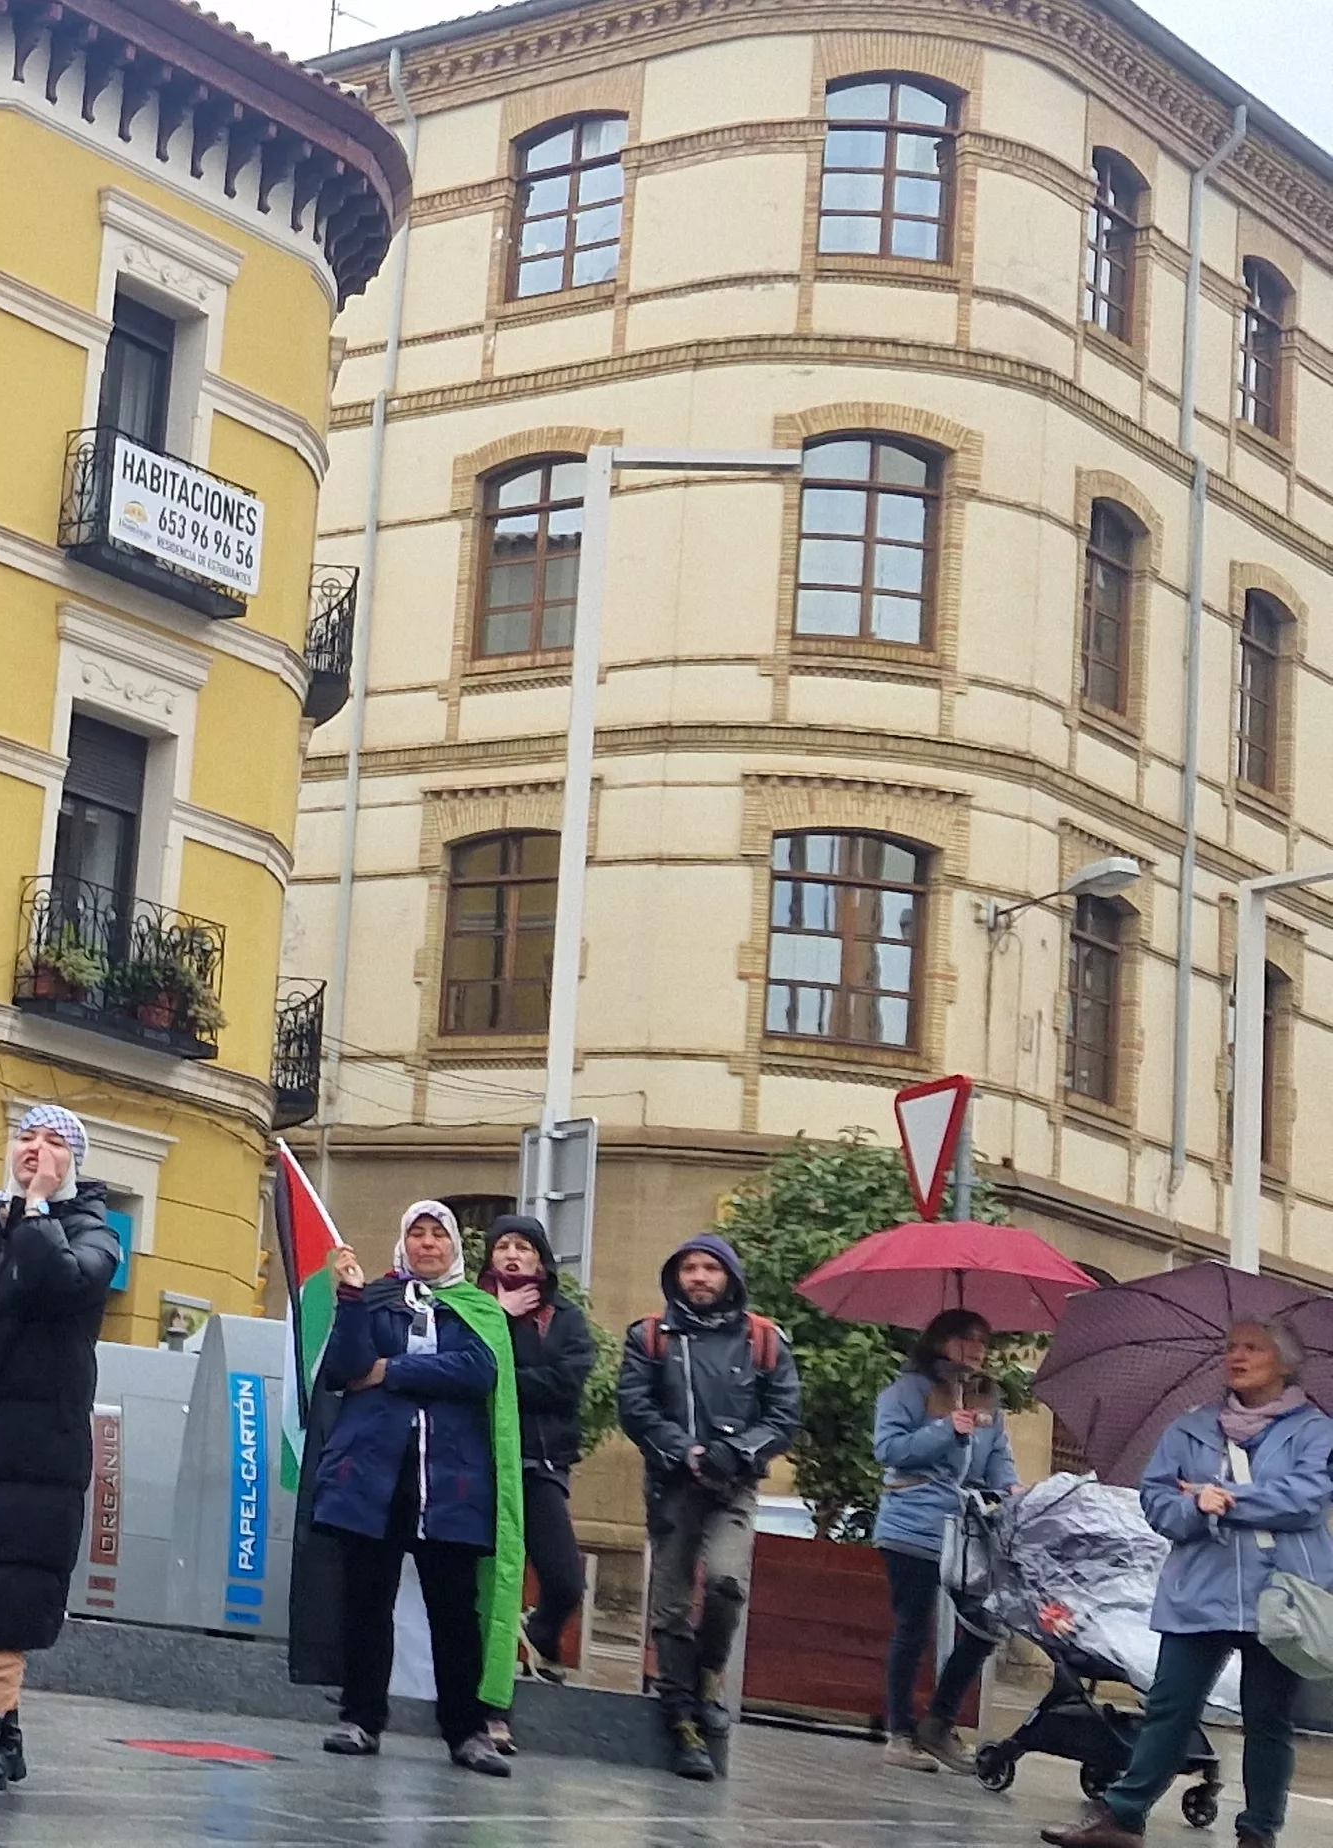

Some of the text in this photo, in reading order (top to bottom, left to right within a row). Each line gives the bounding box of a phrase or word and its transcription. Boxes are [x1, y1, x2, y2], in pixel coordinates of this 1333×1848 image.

[122, 450, 258, 537] HABITACIONES
[158, 507, 187, 540] 653
[191, 520, 209, 550] 96
[214, 530, 231, 560] 96
[236, 539, 254, 569] 56
[97, 1415, 119, 1555] ORGÁNIC
[234, 1380, 258, 1572] PAPEL-CARTÓN
